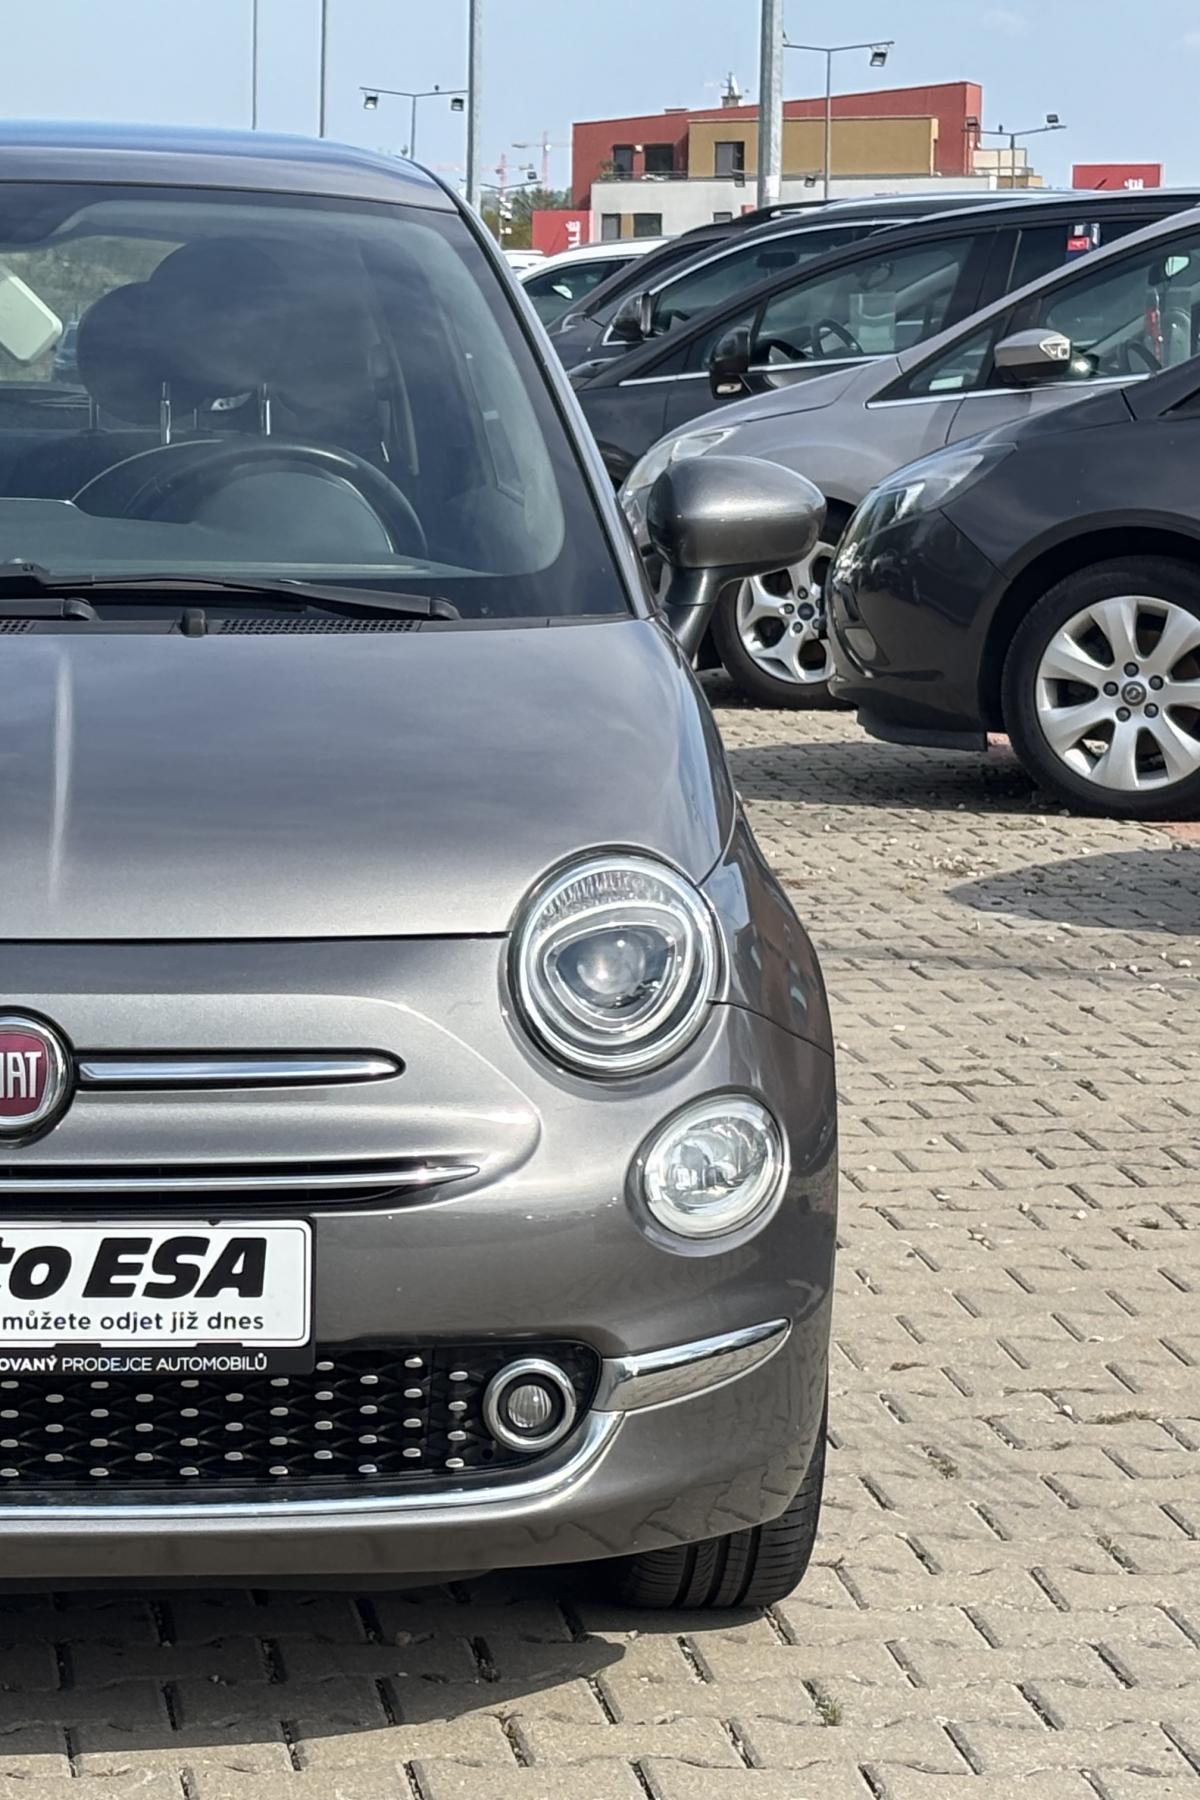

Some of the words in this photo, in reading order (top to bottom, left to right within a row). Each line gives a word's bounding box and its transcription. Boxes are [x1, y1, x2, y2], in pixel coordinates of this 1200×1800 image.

[82, 1236, 267, 1299] ESA
[3, 1310, 91, 1331] můžete
[100, 1312, 163, 1333] odjet
[207, 1312, 264, 1331] dnes
[61, 1356, 152, 1372] PRODEJCE
[156, 1352, 267, 1372] AUTOMOBILŮ
